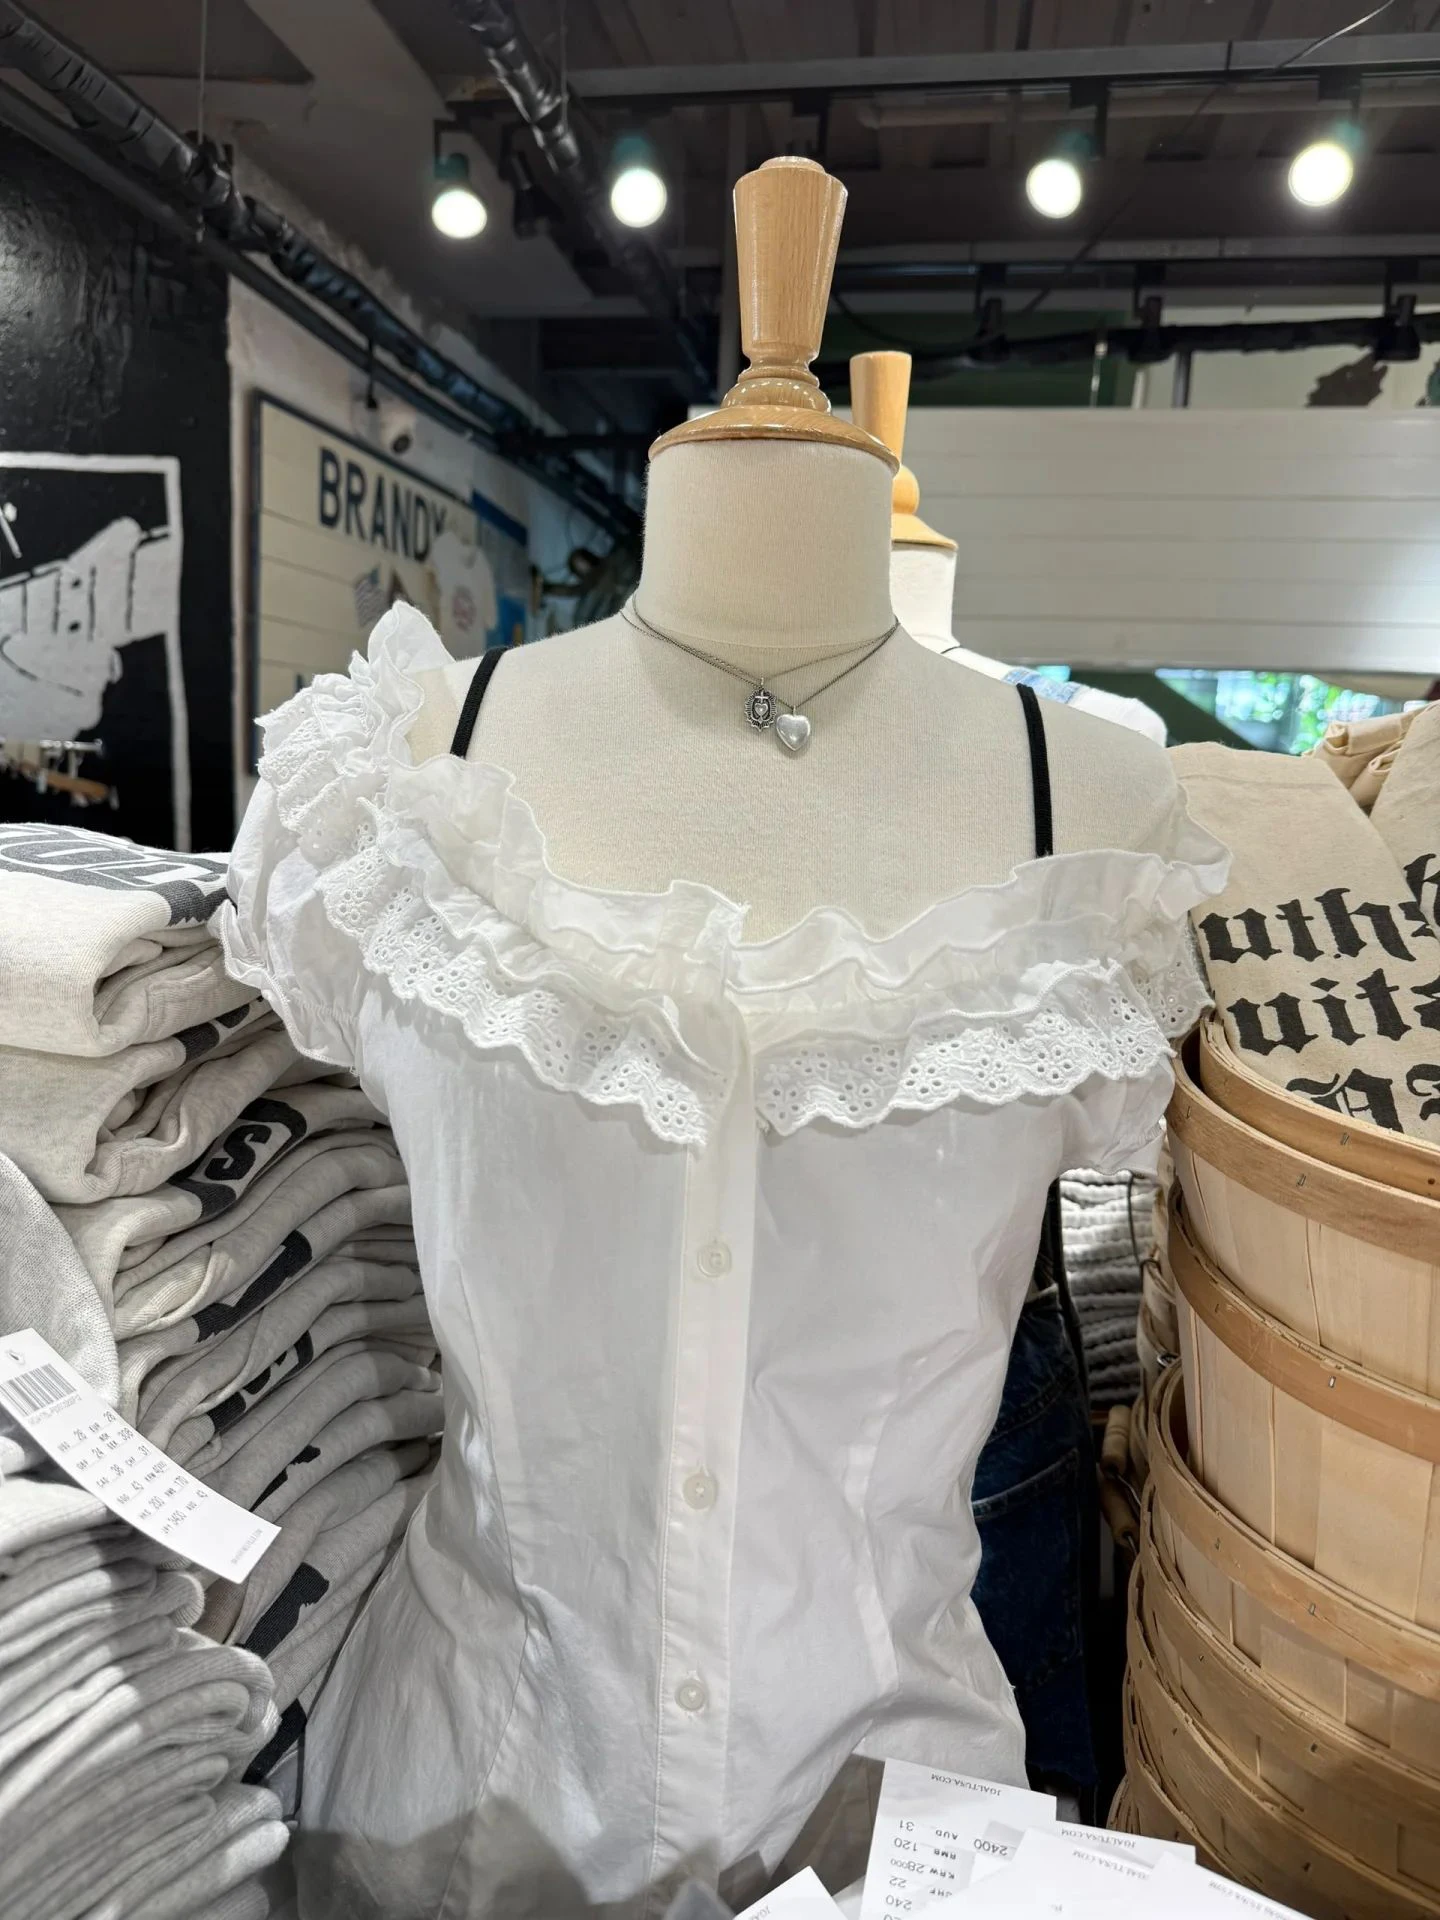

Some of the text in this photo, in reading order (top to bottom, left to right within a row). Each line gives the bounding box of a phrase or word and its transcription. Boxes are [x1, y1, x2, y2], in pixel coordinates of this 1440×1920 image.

[319, 447, 447, 563] BRANDY
[893, 1837, 957, 1861] RMB 120
[899, 1819, 1008, 1857] 2400 AUD 31
[889, 1858, 956, 1880] KRW 28000
[888, 1875, 907, 1888] 22
[885, 1894, 912, 1911] 240
